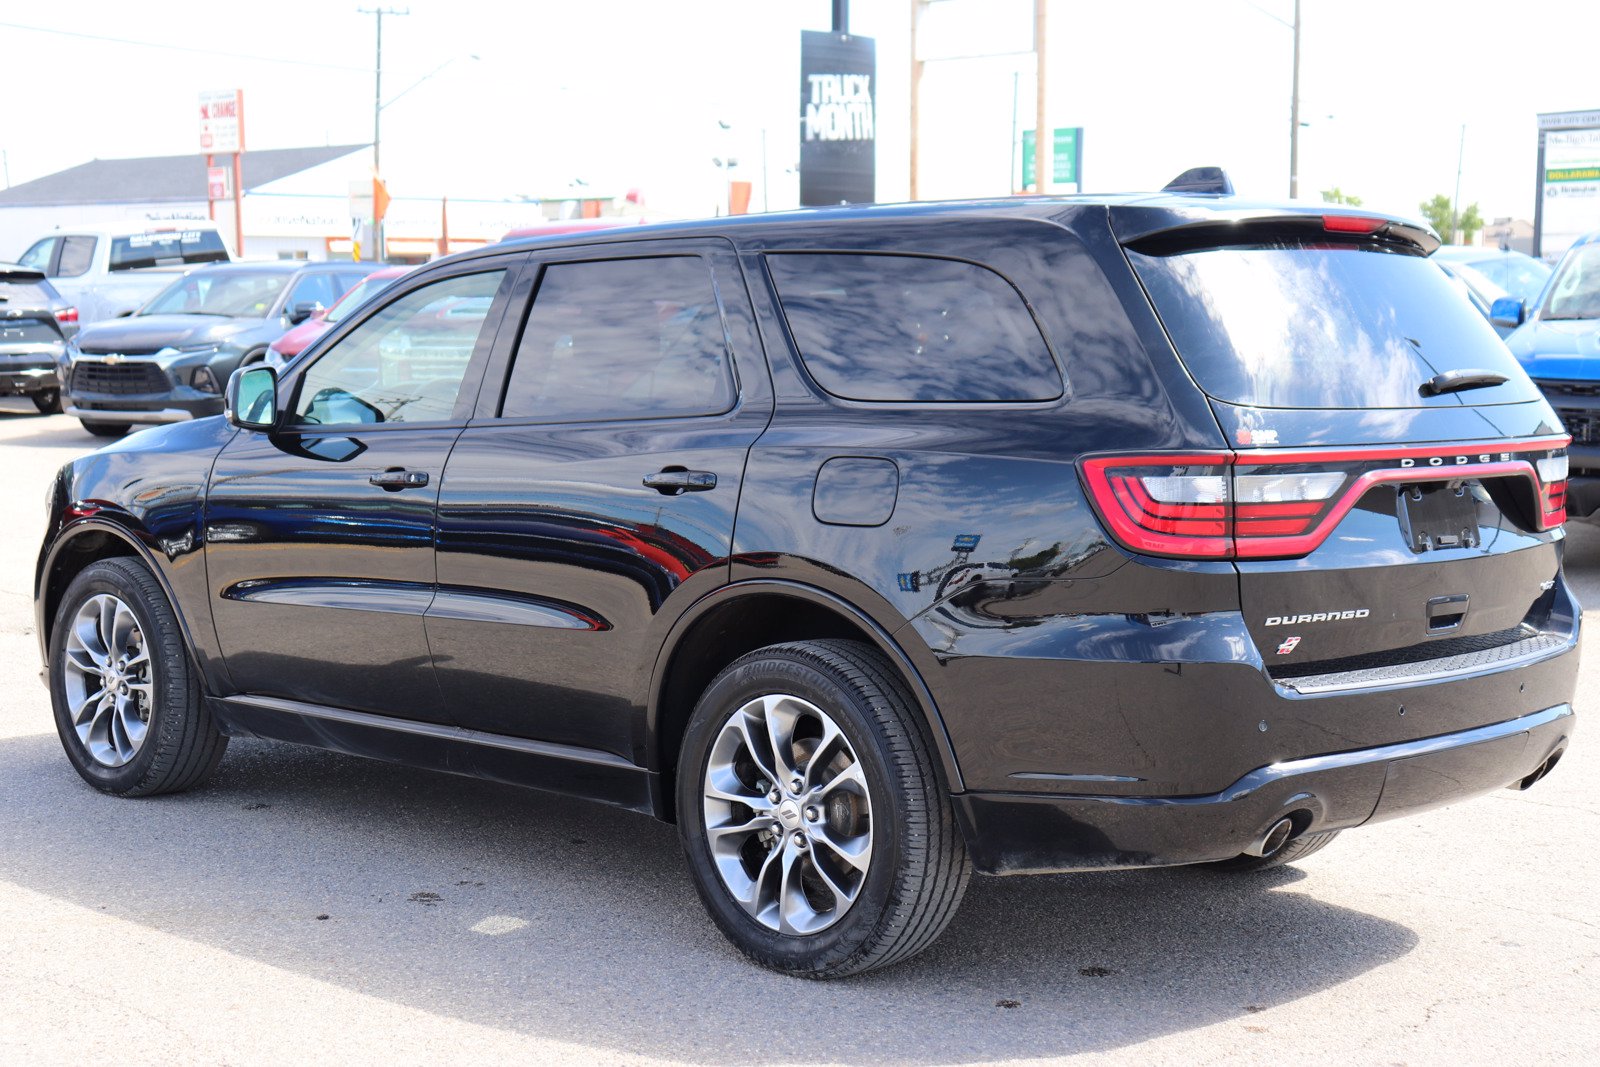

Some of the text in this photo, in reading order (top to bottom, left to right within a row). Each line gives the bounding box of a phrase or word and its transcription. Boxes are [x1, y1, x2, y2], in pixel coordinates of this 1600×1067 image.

[808, 74, 871, 103] TRUCK
[806, 103, 873, 141] MONTH
[1401, 453, 1510, 468] DODGE
[1265, 608, 1370, 626] DURANGO
